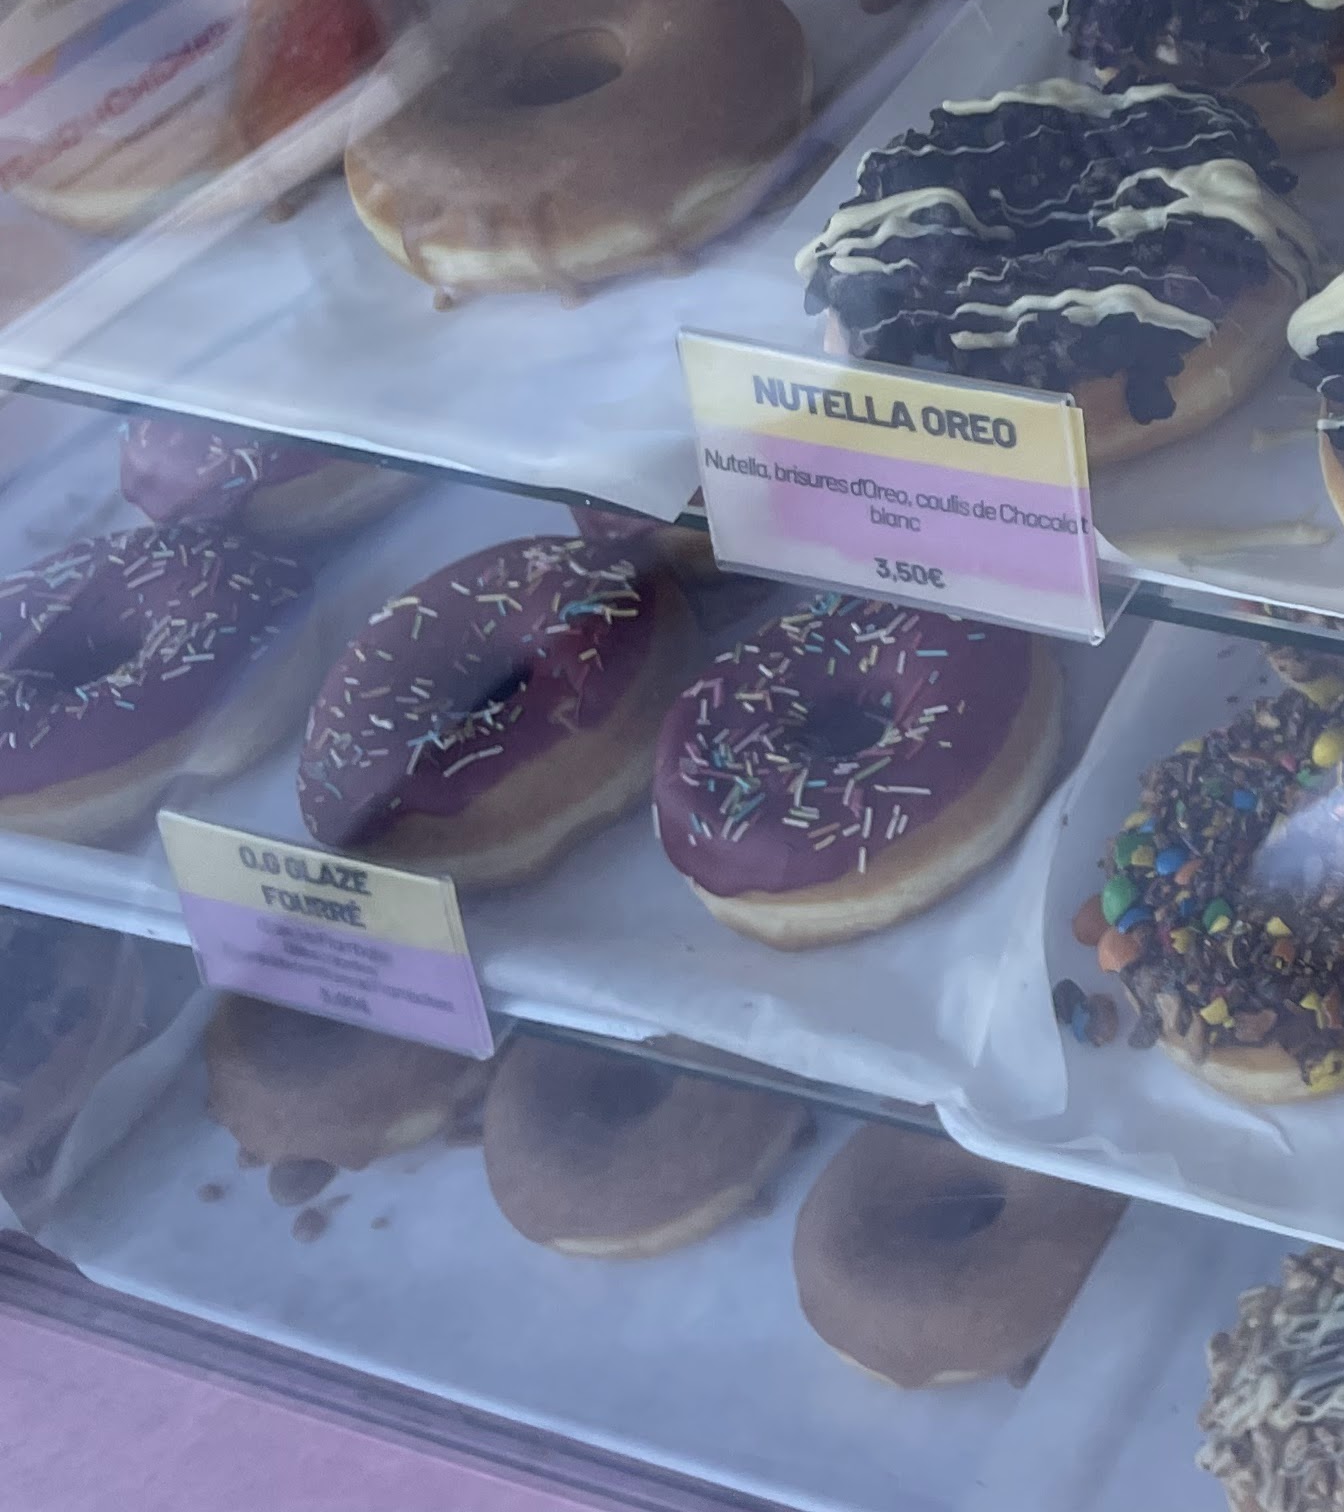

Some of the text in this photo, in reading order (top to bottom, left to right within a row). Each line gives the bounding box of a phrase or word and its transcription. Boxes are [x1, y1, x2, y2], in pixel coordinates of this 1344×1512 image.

[752, 375, 1017, 449] NUTELLA OREO
[704, 448, 772, 480] Nutella,
[774, 461, 849, 494] brisures
[916, 492, 970, 518] coulis
[972, 500, 997, 521] de
[999, 502, 1090, 535] Chocolat
[870, 505, 921, 533] blanc
[873, 556, 946, 589] 3,50€
[285, 856, 372, 896] GLAZE
